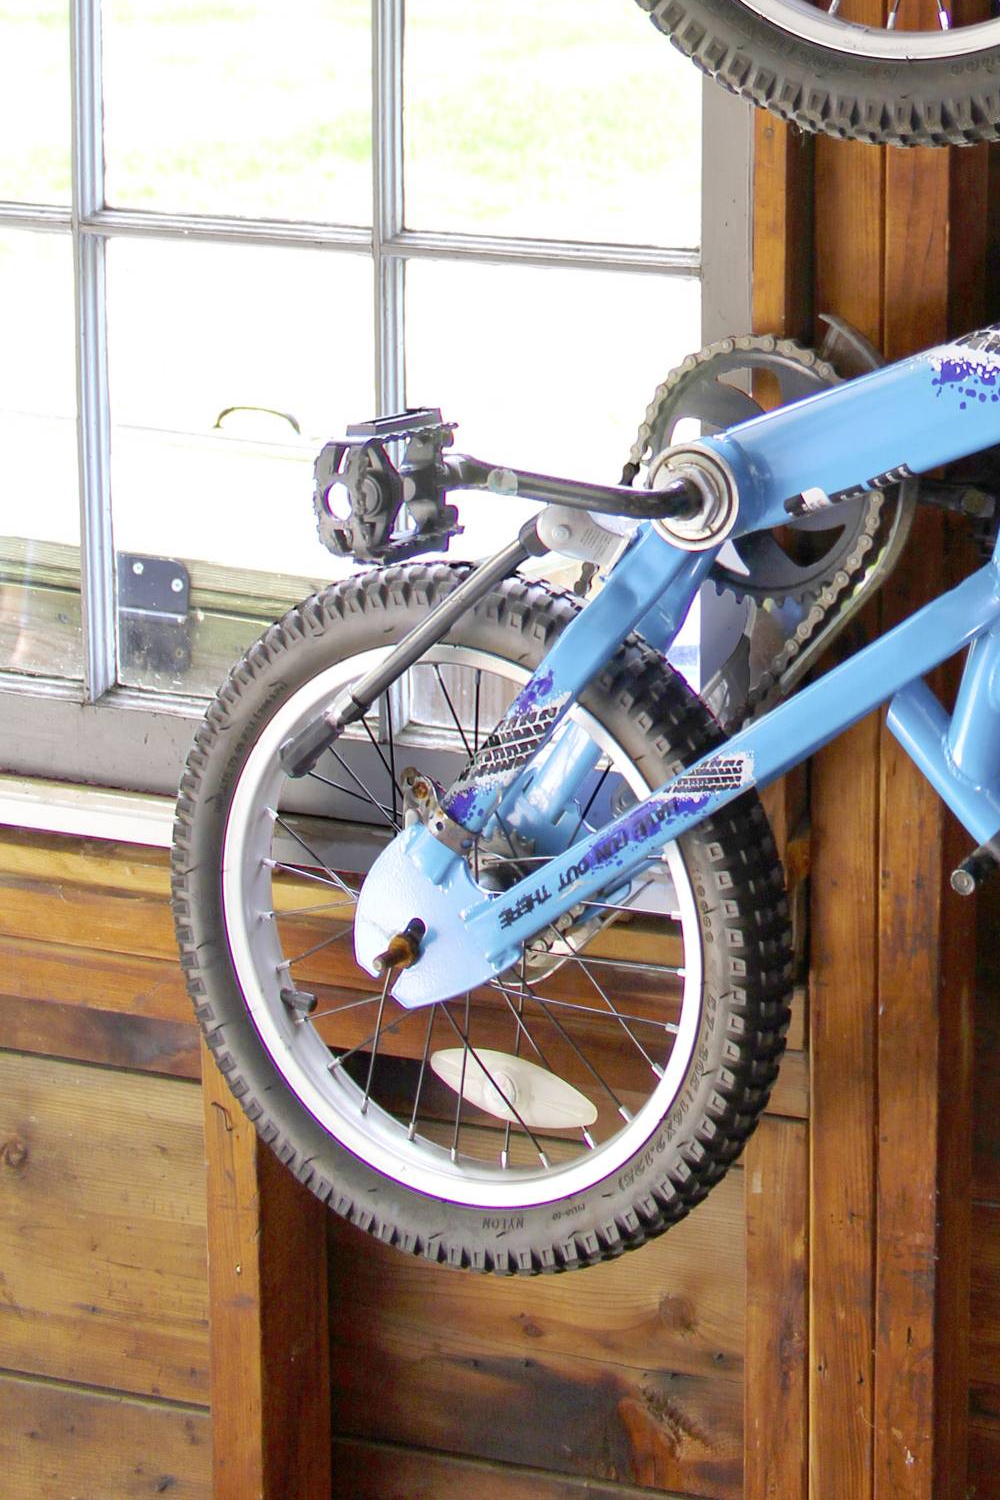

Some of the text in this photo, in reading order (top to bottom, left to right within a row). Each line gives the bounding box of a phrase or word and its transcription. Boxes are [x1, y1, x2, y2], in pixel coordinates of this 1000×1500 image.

[557, 856, 591, 892] OUT
[498, 884, 552, 930] THERE
[482, 1216, 525, 1230] NYLON
